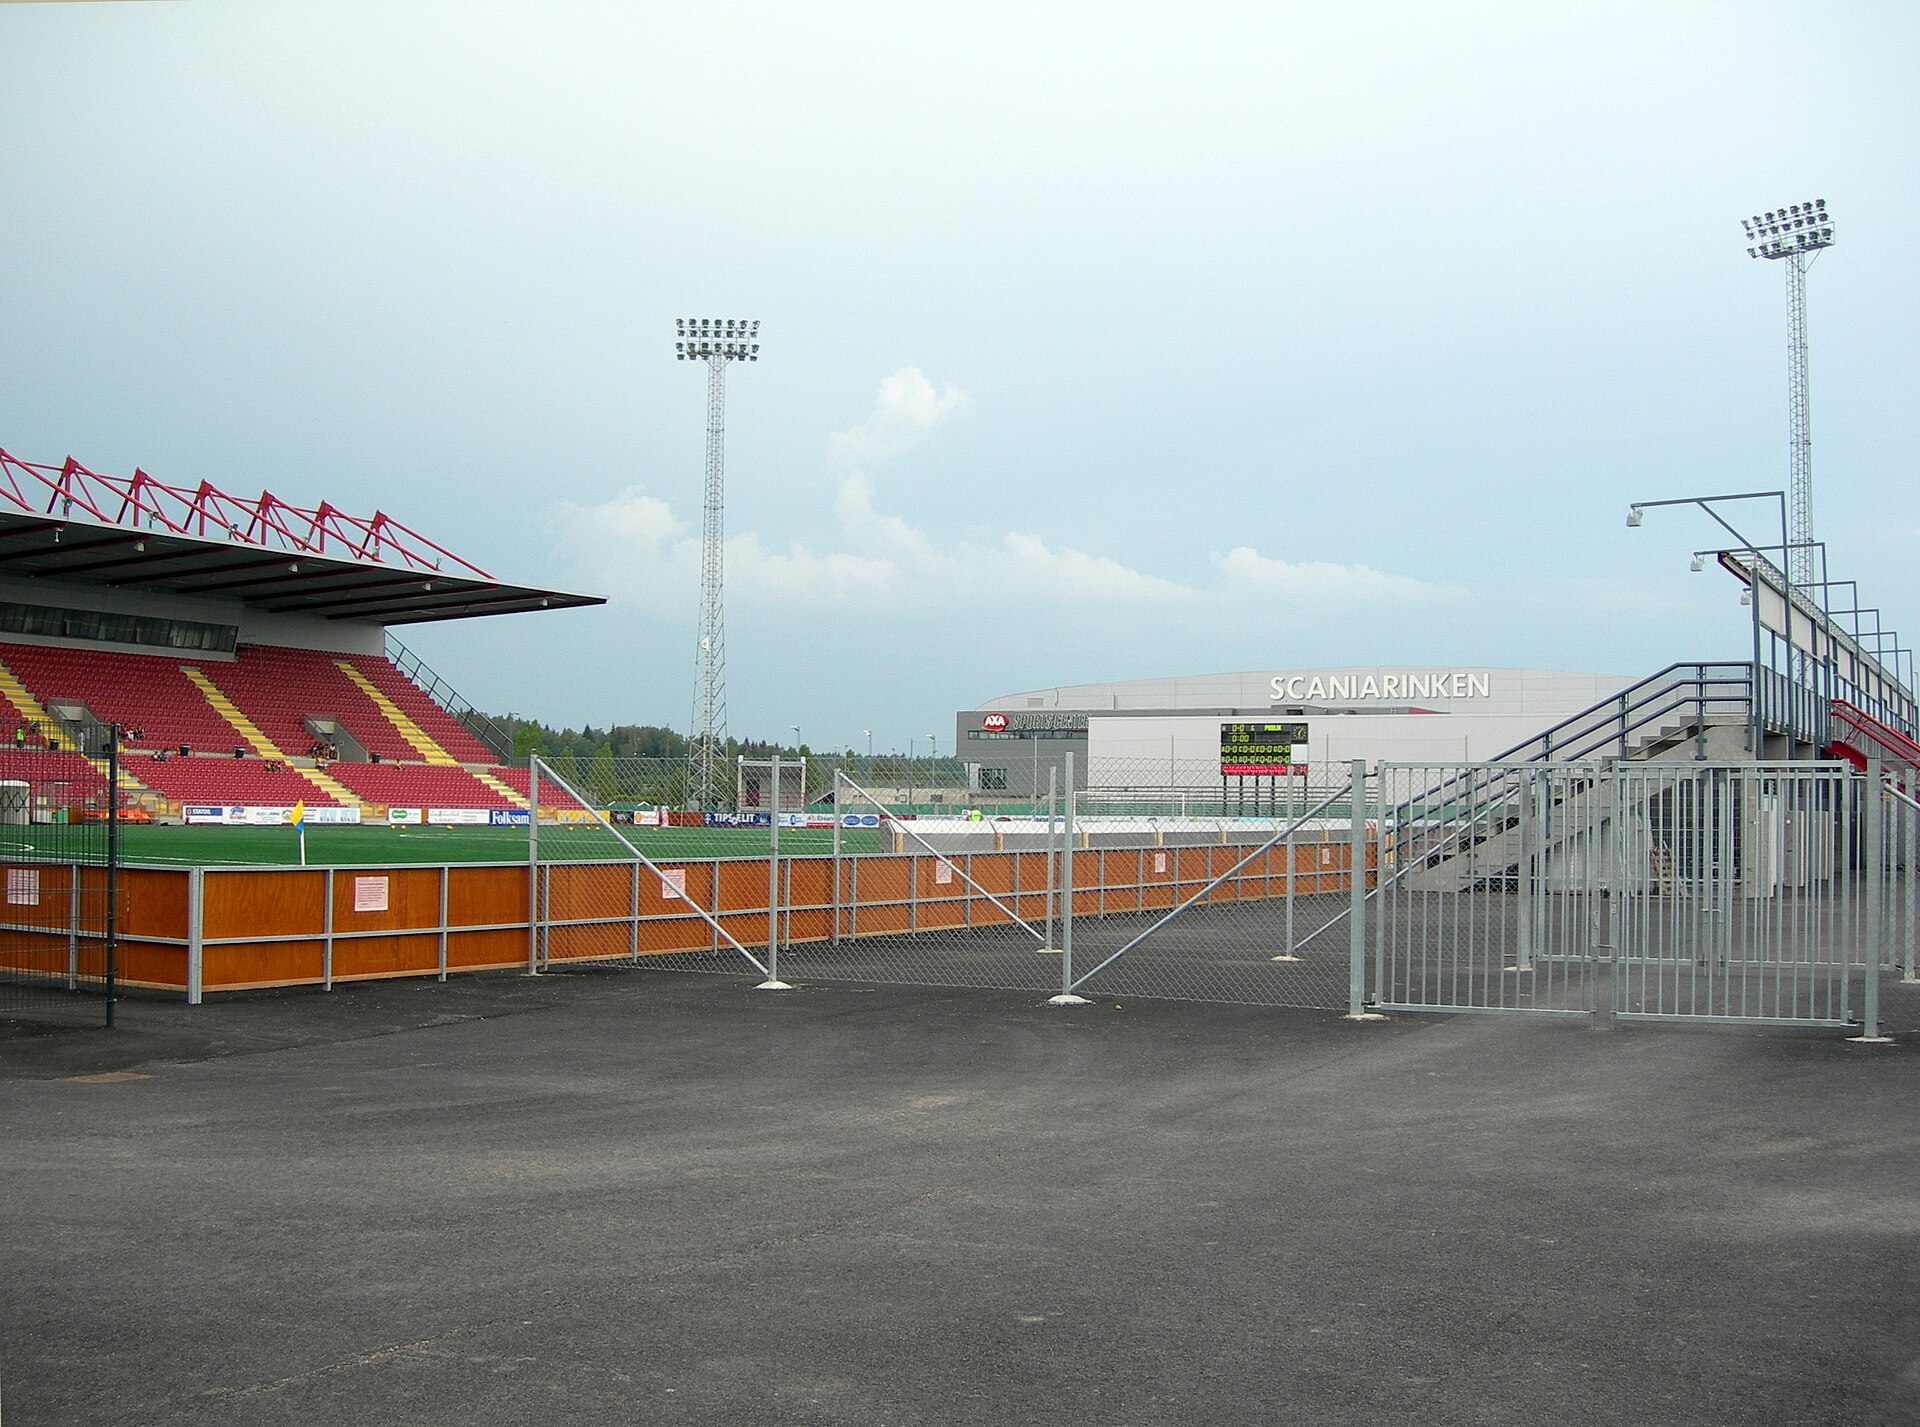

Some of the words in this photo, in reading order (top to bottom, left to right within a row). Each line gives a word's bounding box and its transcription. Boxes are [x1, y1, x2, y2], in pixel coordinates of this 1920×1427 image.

[1270, 672, 1490, 700] SCANIARINKEN
[984, 715, 1006, 726] AXA
[492, 811, 530, 825] Folksam
